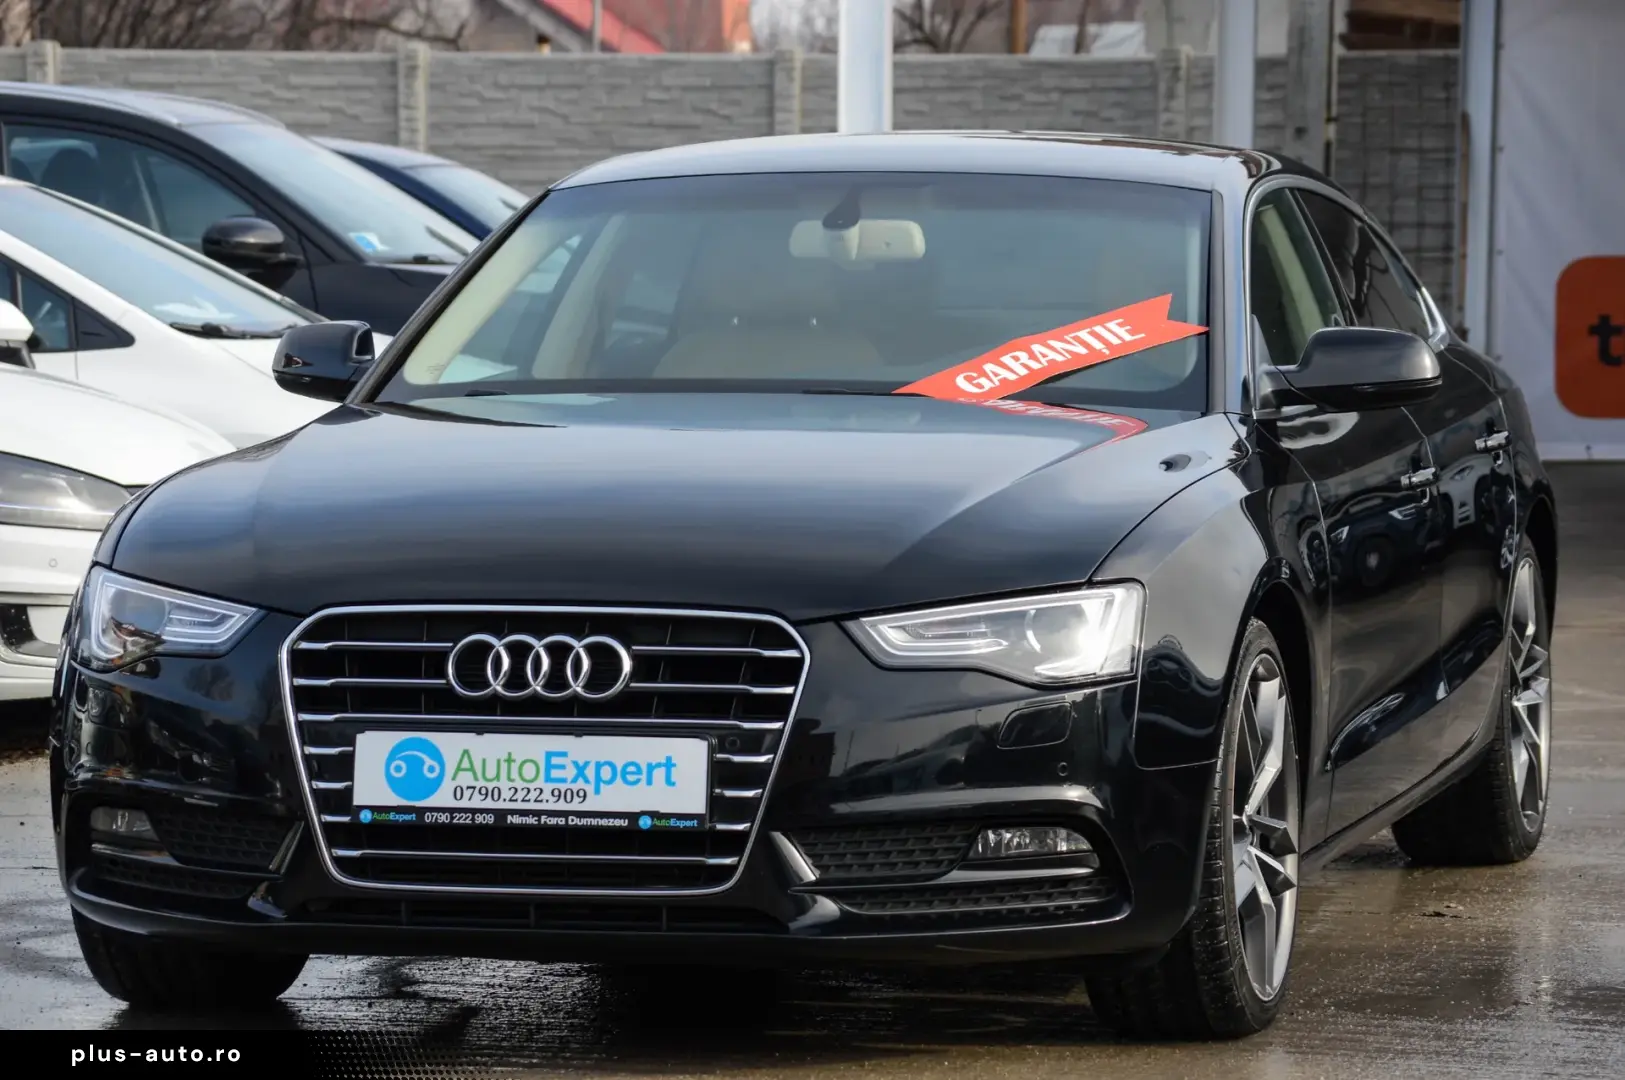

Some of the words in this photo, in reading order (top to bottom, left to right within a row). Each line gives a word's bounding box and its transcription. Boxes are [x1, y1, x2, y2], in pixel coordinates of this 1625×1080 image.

[954, 318, 1146, 393] GARANȚIE
[451, 748, 677, 795] AutoExpert
[453, 785, 588, 804] 0790.222.909
[372, 811, 417, 822] AutoExpert
[424, 811, 450, 823] 0790
[452, 812, 472, 824] 222
[474, 812, 495, 824] 909
[507, 814, 539, 825] Nimic
[540, 815, 566, 826] Fara
[568, 816, 629, 827] Dumnezeu
[652, 817, 698, 828] AutoExpert
